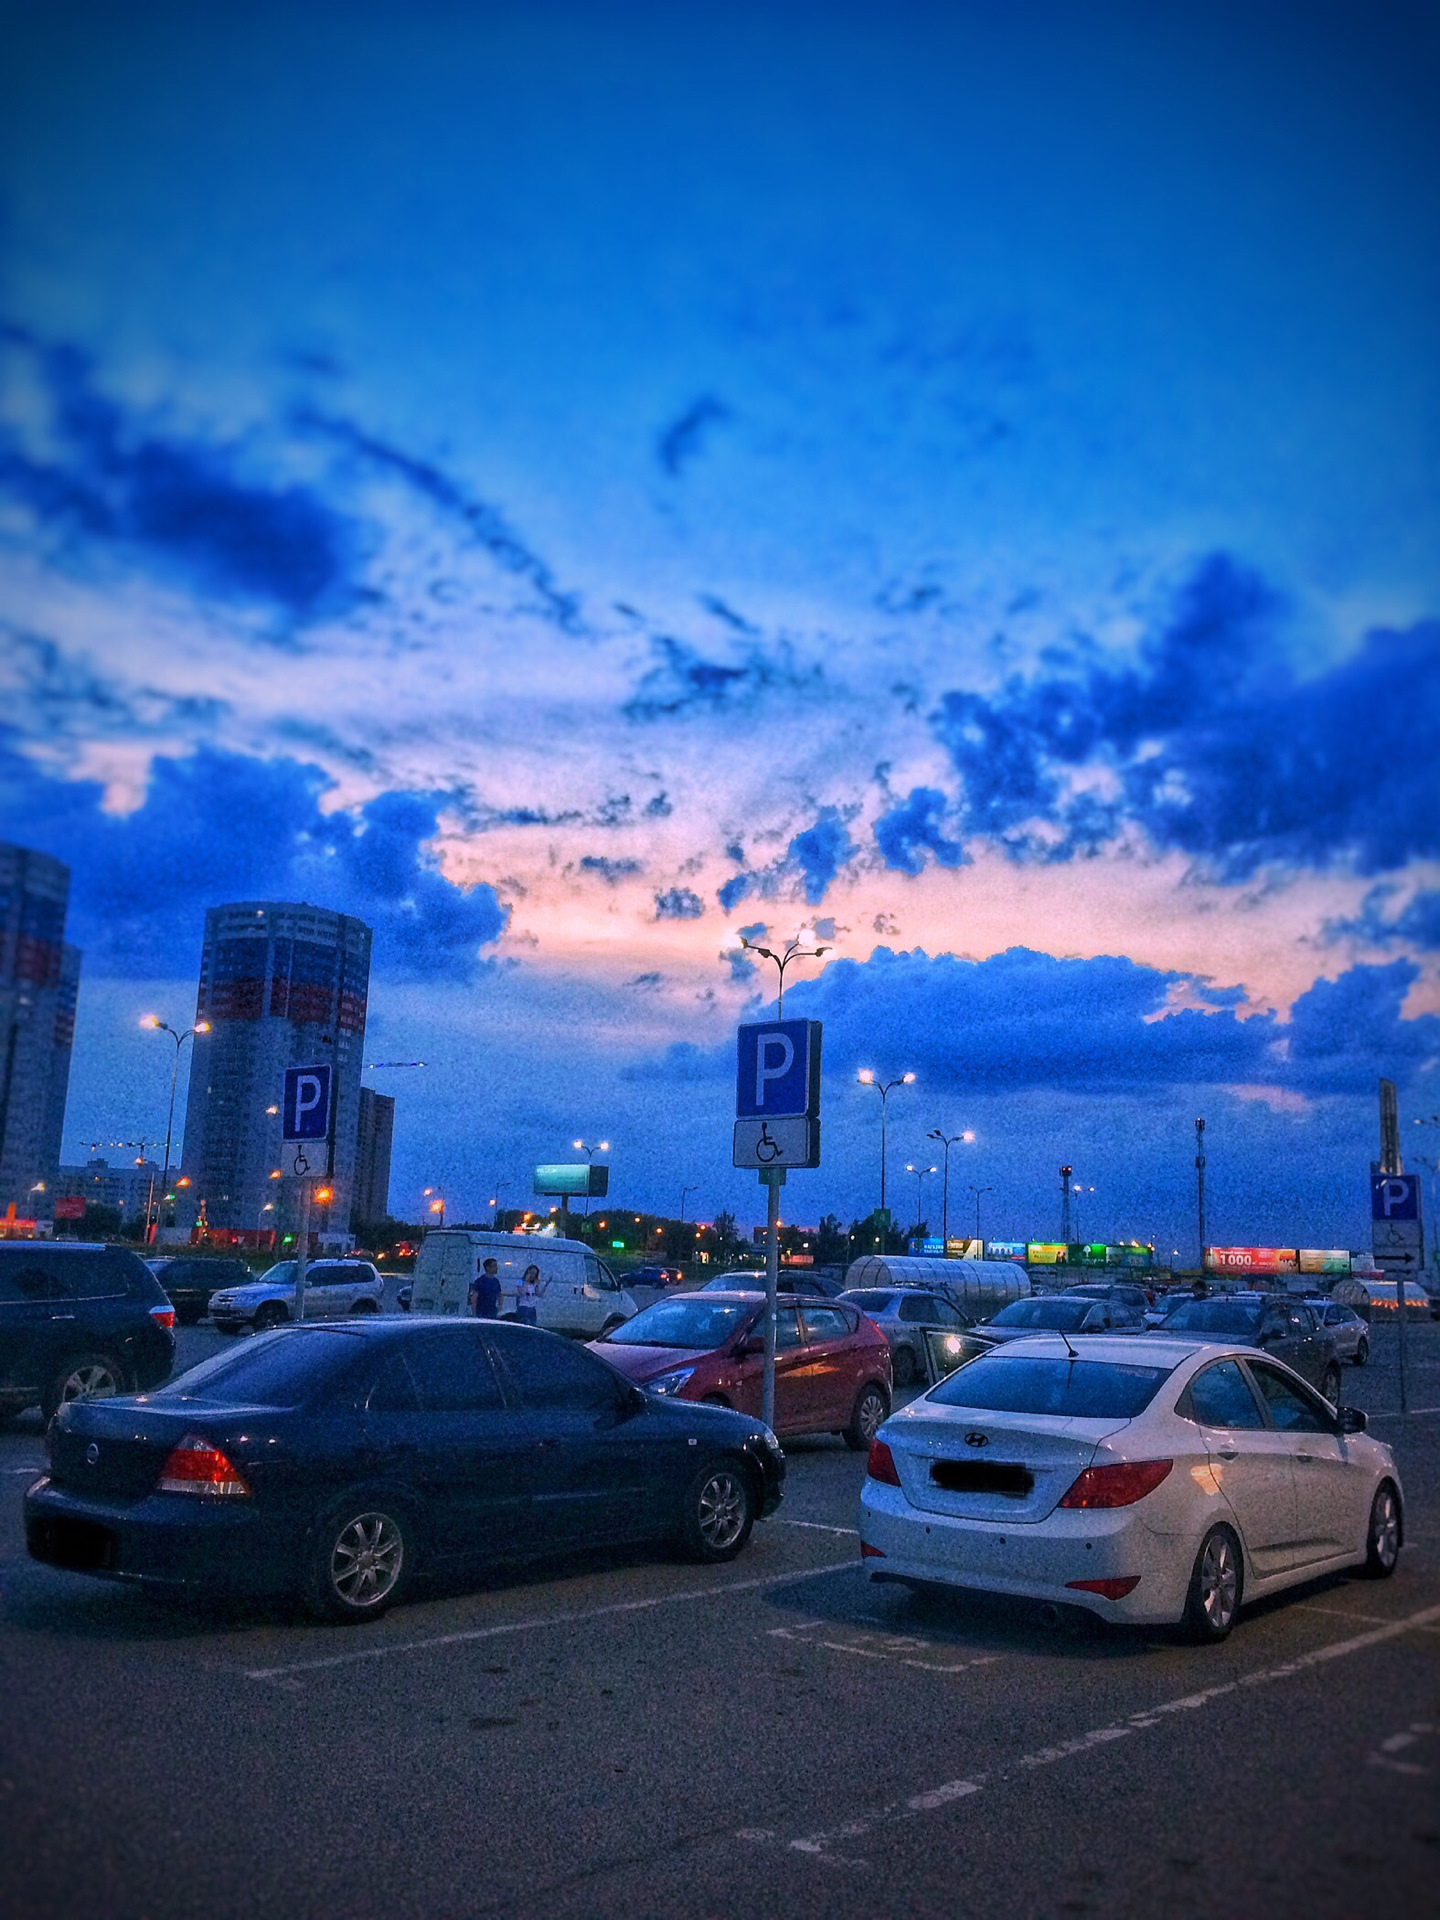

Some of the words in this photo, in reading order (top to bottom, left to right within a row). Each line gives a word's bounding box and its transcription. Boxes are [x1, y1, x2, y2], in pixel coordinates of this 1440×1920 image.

[755, 1032, 794, 1106] P
[295, 1074, 321, 1132] P
[1383, 1178, 1409, 1216] P
